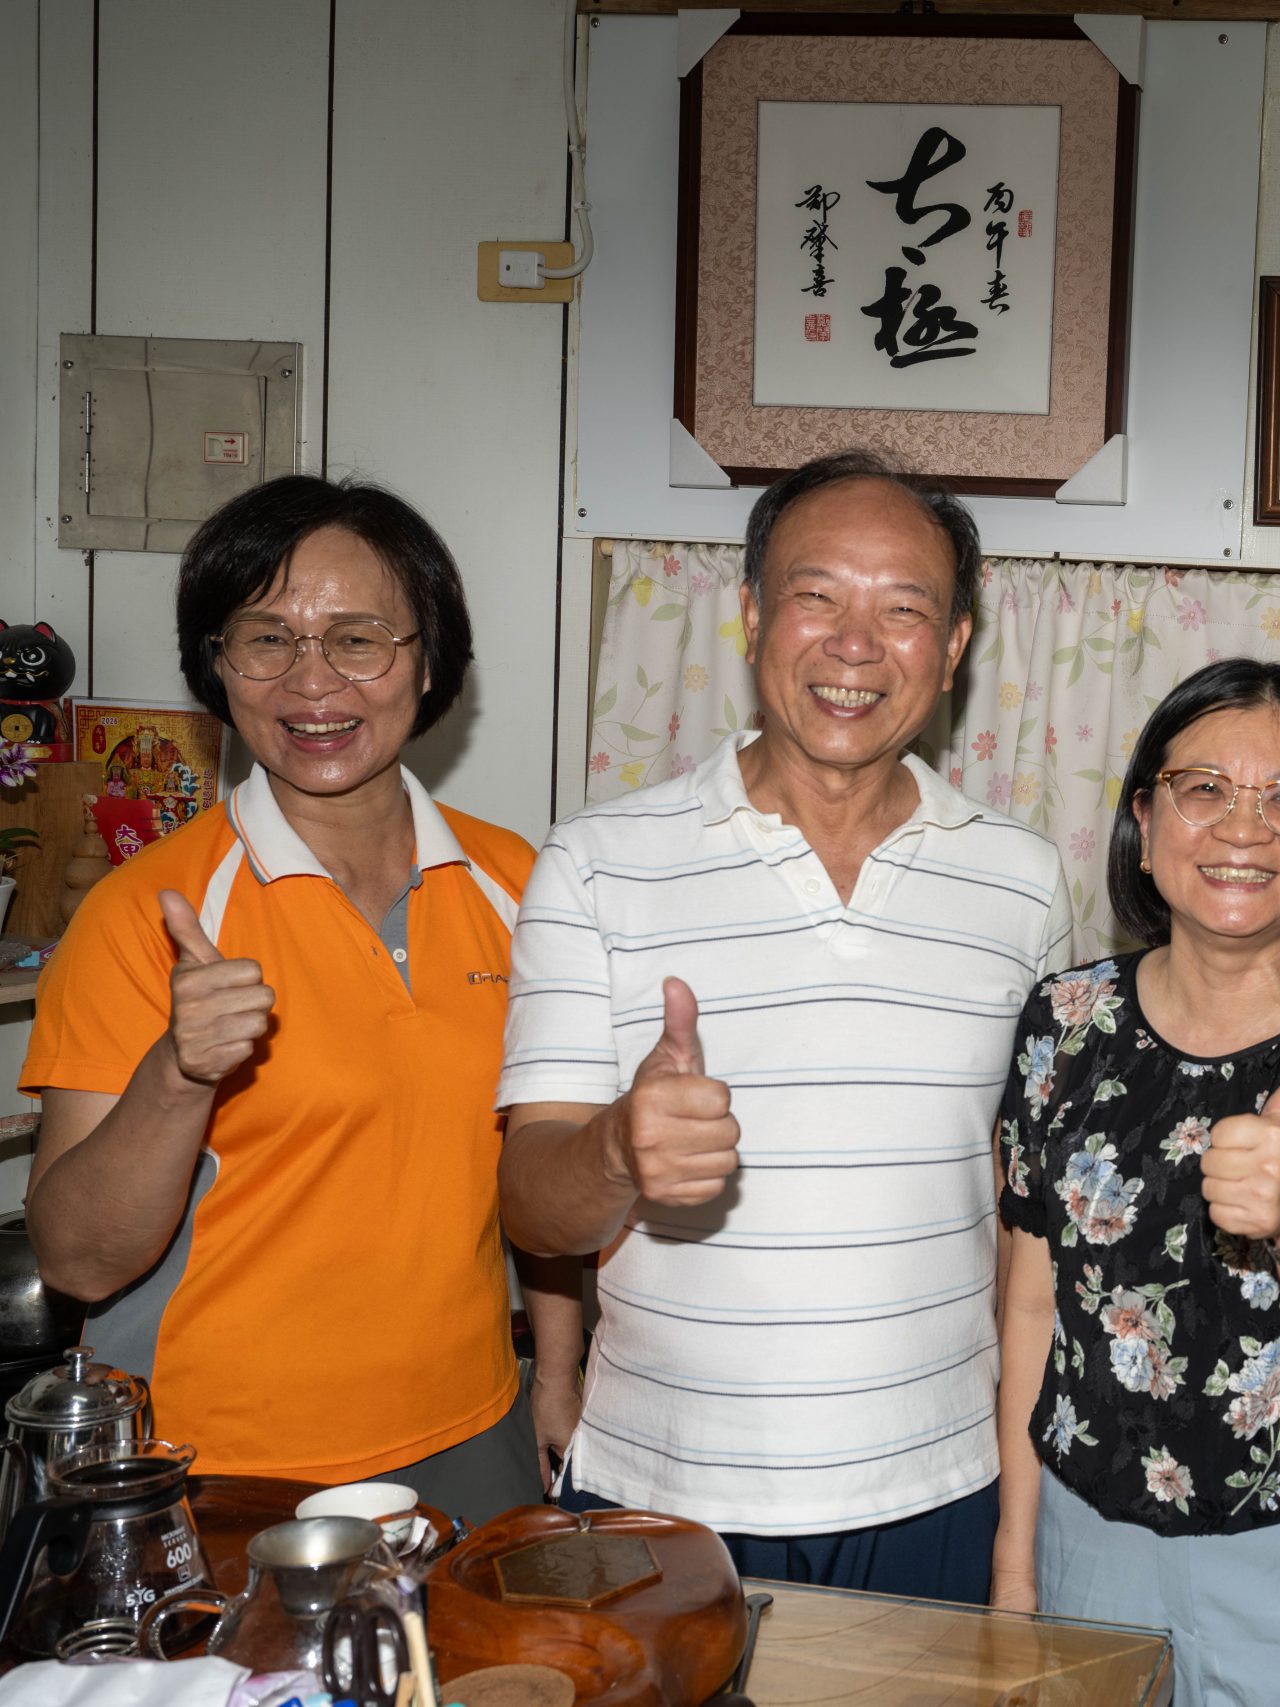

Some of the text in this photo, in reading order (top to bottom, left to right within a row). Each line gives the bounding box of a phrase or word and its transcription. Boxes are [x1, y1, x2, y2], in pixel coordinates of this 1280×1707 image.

[980, 182, 1014, 316] 丙午春
[166, 1542, 192, 1569] 600
